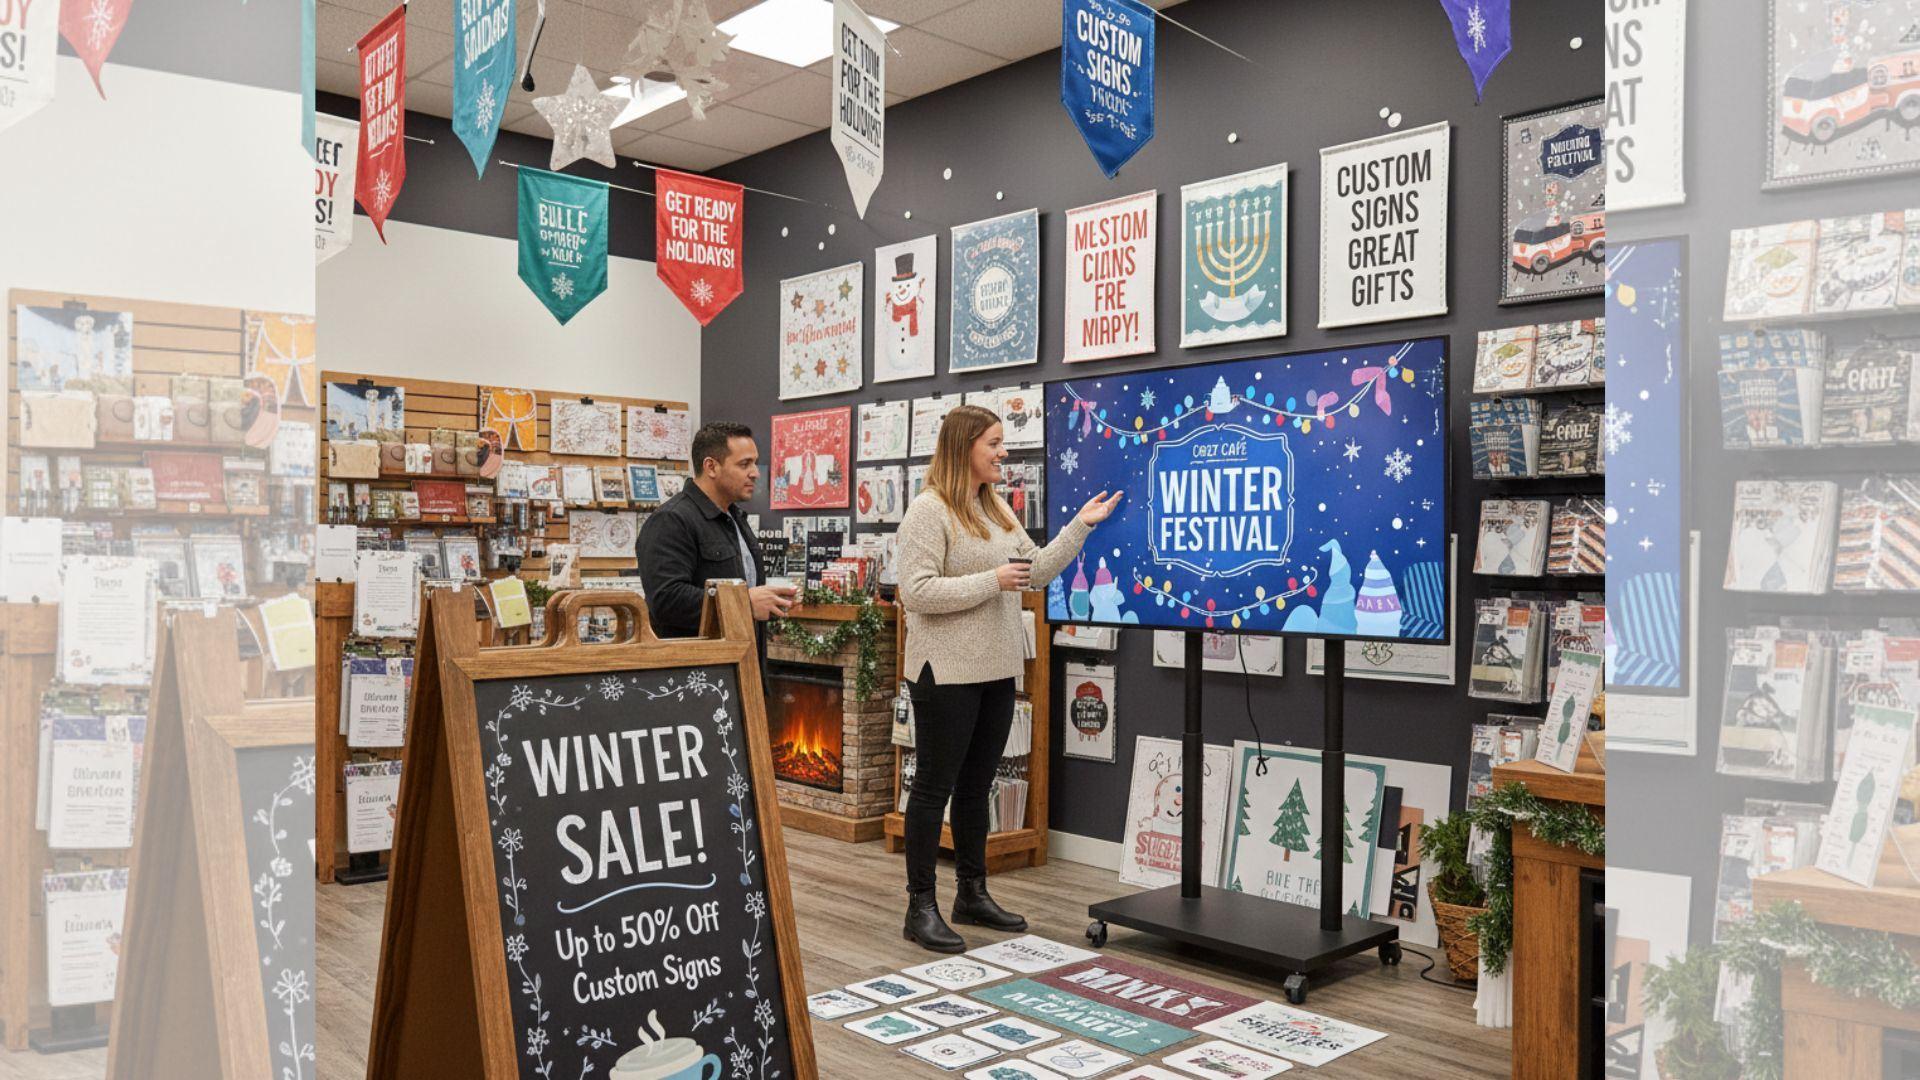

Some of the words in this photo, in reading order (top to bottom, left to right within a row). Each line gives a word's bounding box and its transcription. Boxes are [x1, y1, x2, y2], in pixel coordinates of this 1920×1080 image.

[1076, 9, 1143, 67] CUSTOM
[1086, 48, 1132, 96] SIGNS
[1337, 149, 1431, 198] CUSTOM
[665, 190, 693, 215] GET
[694, 195, 737, 223] READY
[671, 215, 699, 240] FOR
[701, 220, 729, 245] THE
[1351, 190, 1419, 232] SIGNS
[1348, 228, 1419, 270] GREAT
[1095, 279, 1126, 312] FRE
[1352, 268, 1414, 307] GIFTS
[1159, 466, 1283, 514] WINTER
[1161, 515, 1279, 552] FESTIVAL
[522, 724, 708, 797] WINTER
[555, 798, 708, 885] SALE!
[555, 928, 589, 968] Up
[593, 925, 616, 953] to
[621, 906, 680, 948] 50%
[686, 900, 719, 935] Off
[573, 966, 659, 1003] Custom
[663, 954, 721, 990] Signs
